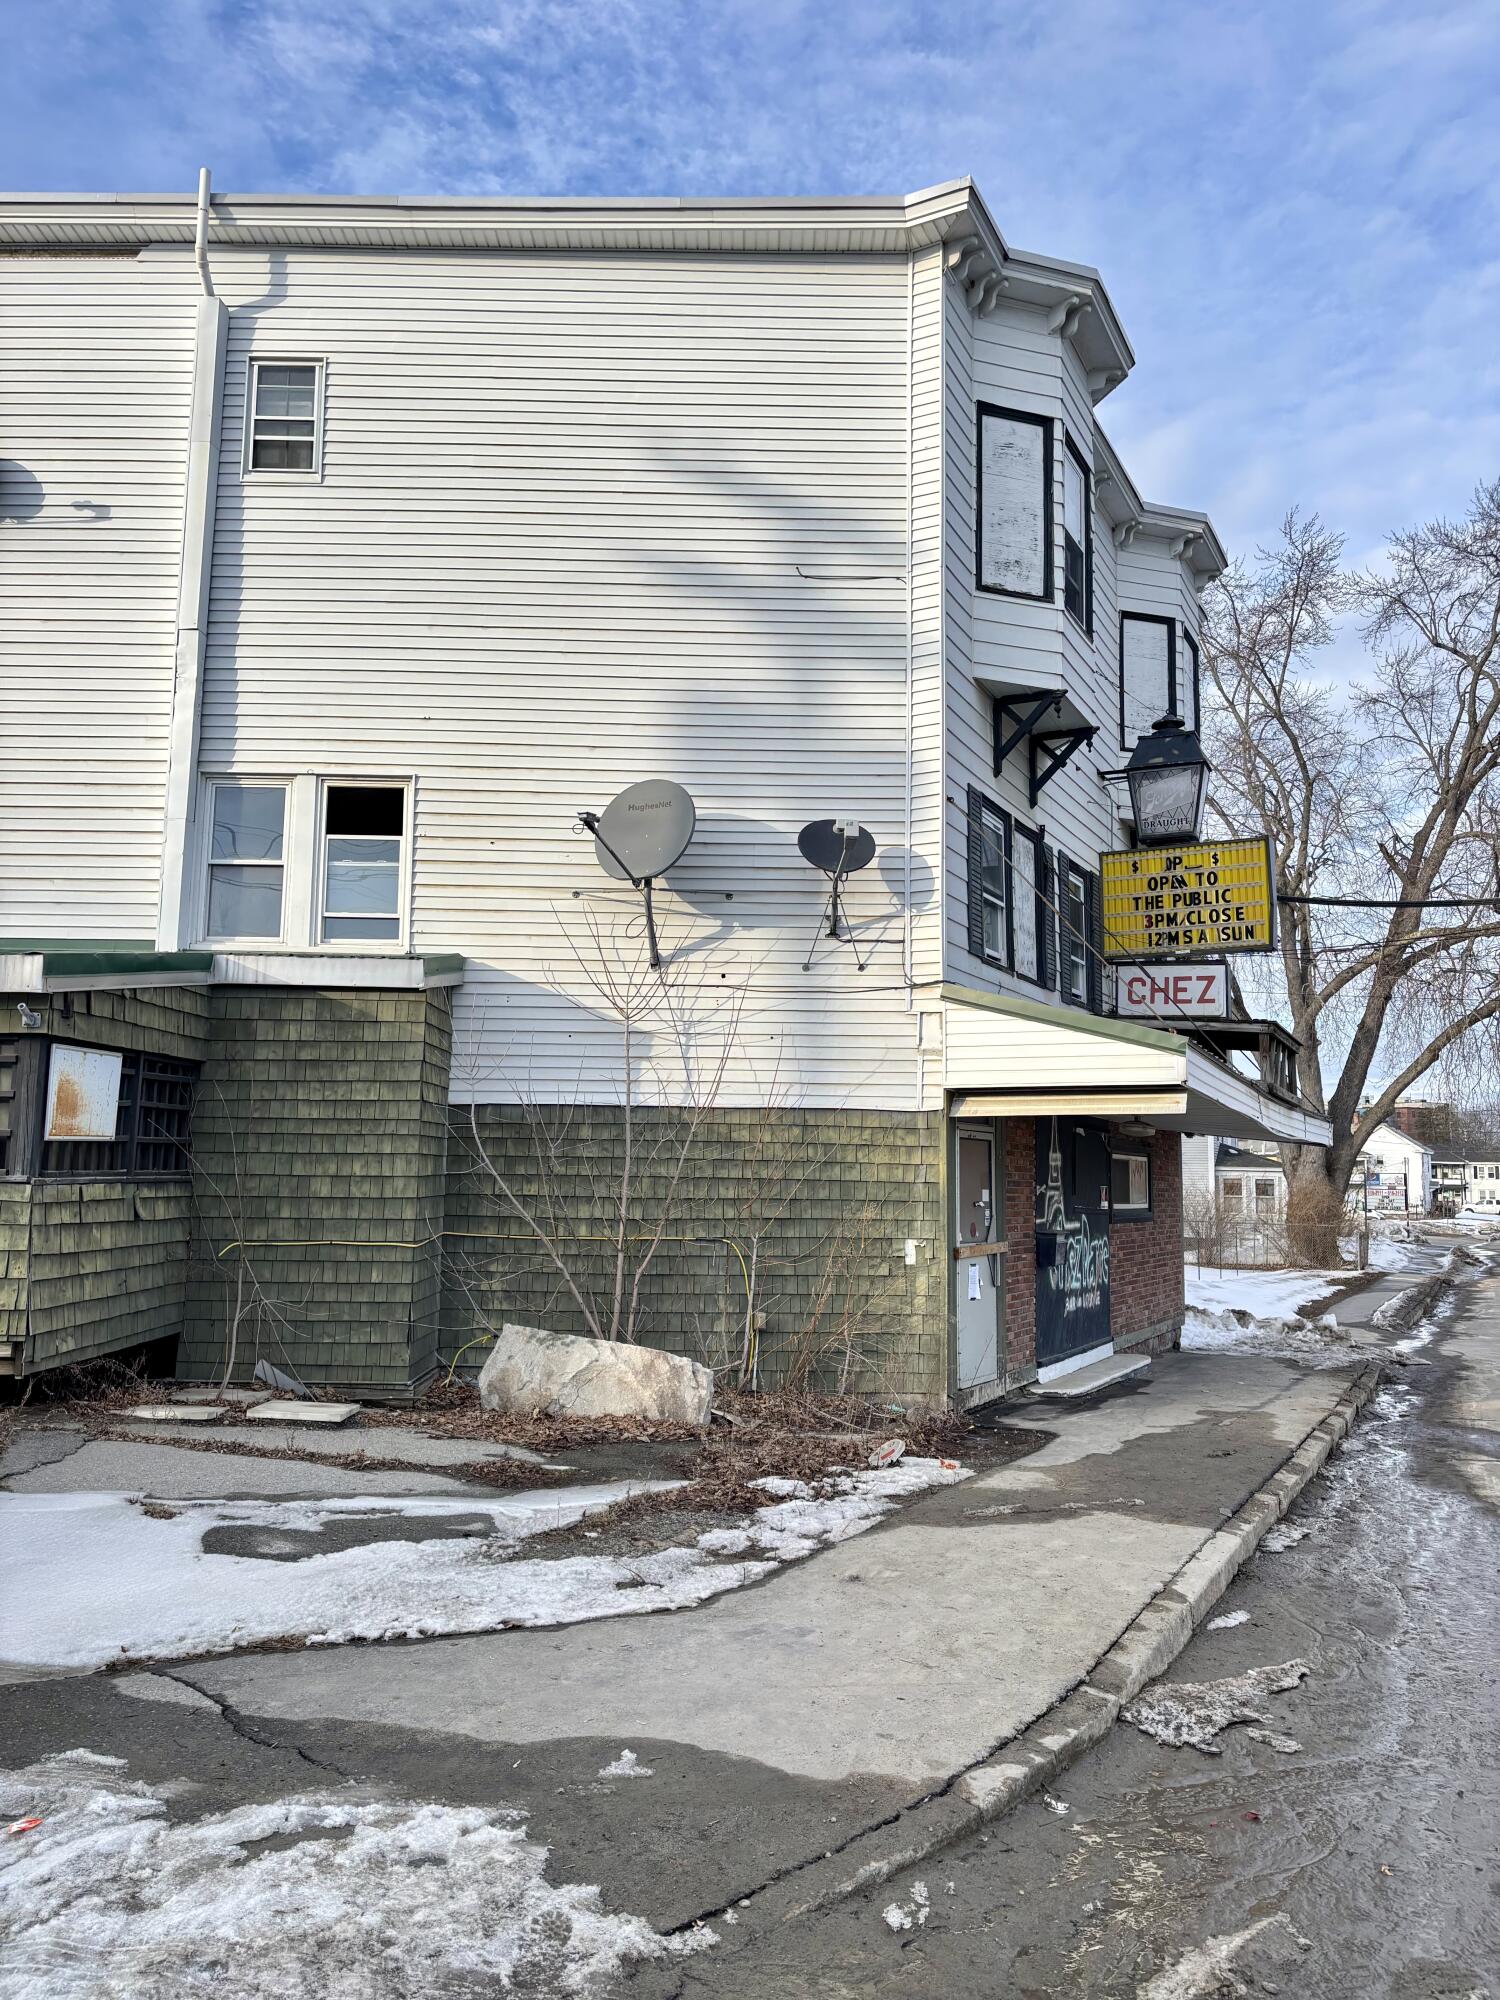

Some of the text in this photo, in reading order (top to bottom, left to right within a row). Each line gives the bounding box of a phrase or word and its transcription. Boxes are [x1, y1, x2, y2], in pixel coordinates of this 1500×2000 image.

[628, 800, 673, 812] HughesNet
[1131, 860, 1139, 874] $
[1211, 852, 1219, 866] $
[1195, 871, 1218, 886] TO
[1133, 888, 1231, 911] THE PUBLIC
[1127, 975, 1216, 1005] CHEZ
